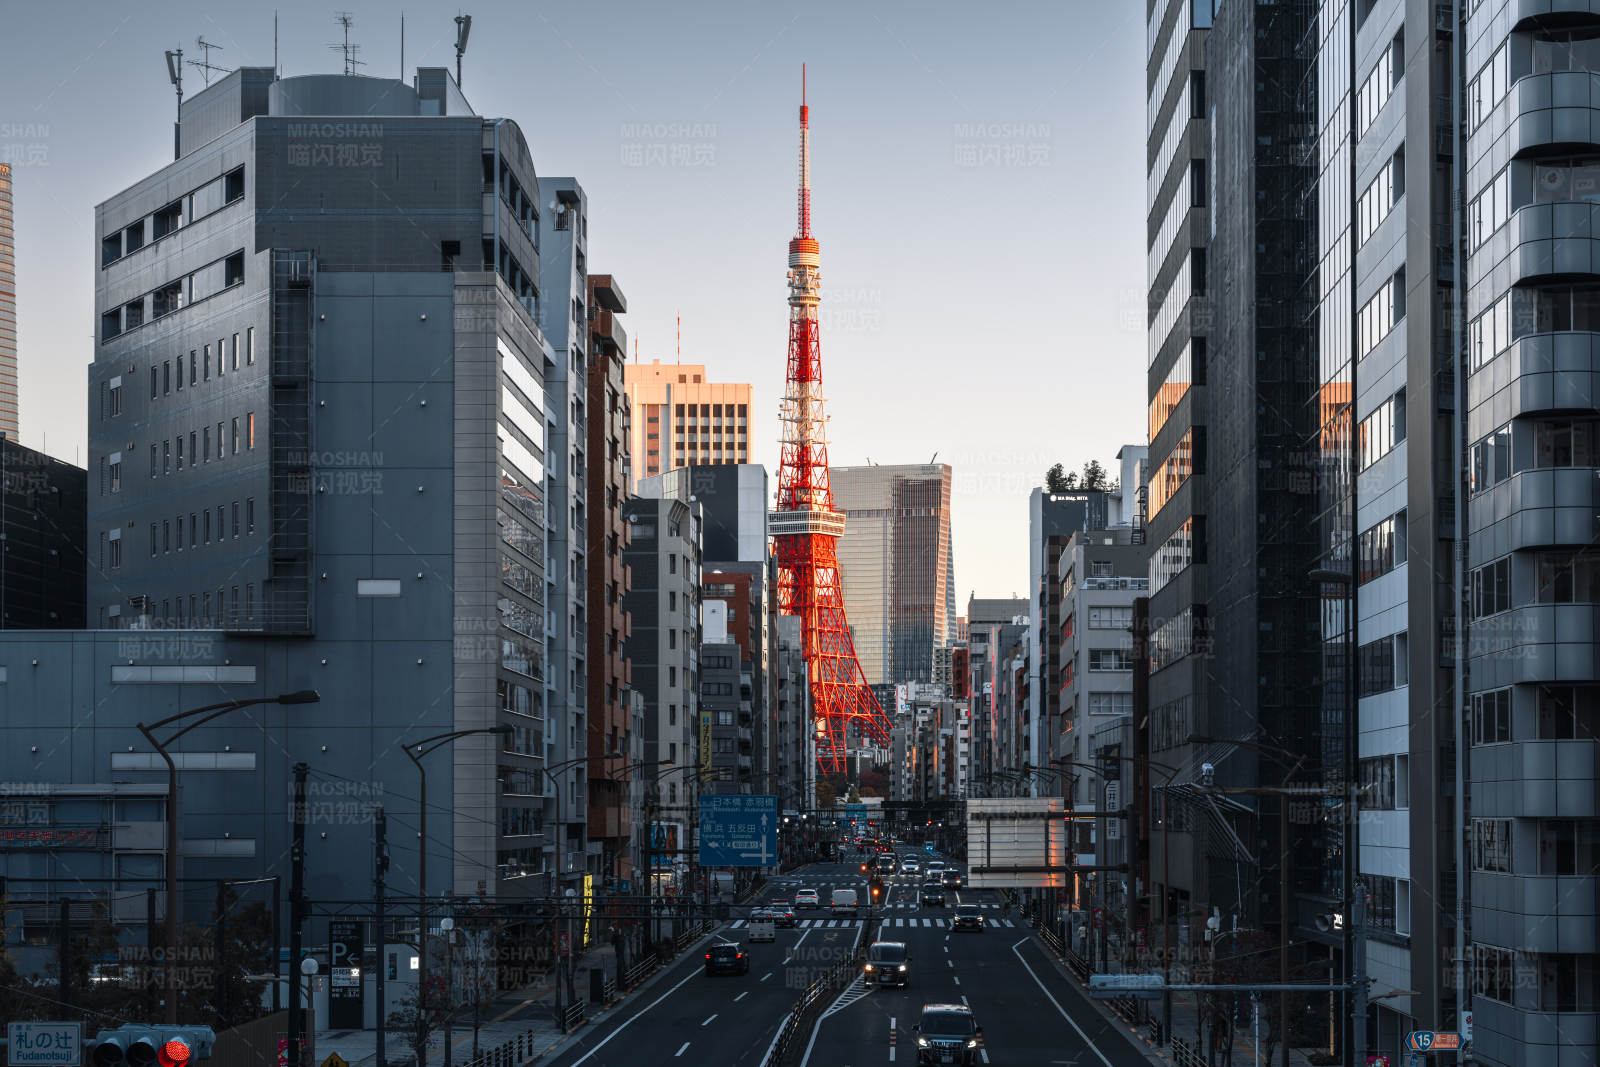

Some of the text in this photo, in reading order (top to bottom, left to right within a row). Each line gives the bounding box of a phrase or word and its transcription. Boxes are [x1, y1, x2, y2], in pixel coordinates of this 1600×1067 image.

[1107, 783, 1117, 837] 三井住銀行
[727, 824, 755, 833] 五反田
[331, 942, 348, 966] P
[16, 1031, 72, 1049] 札の辻
[1417, 1034, 1431, 1047] 15
[17, 1051, 72, 1062] Fudanotsuji
